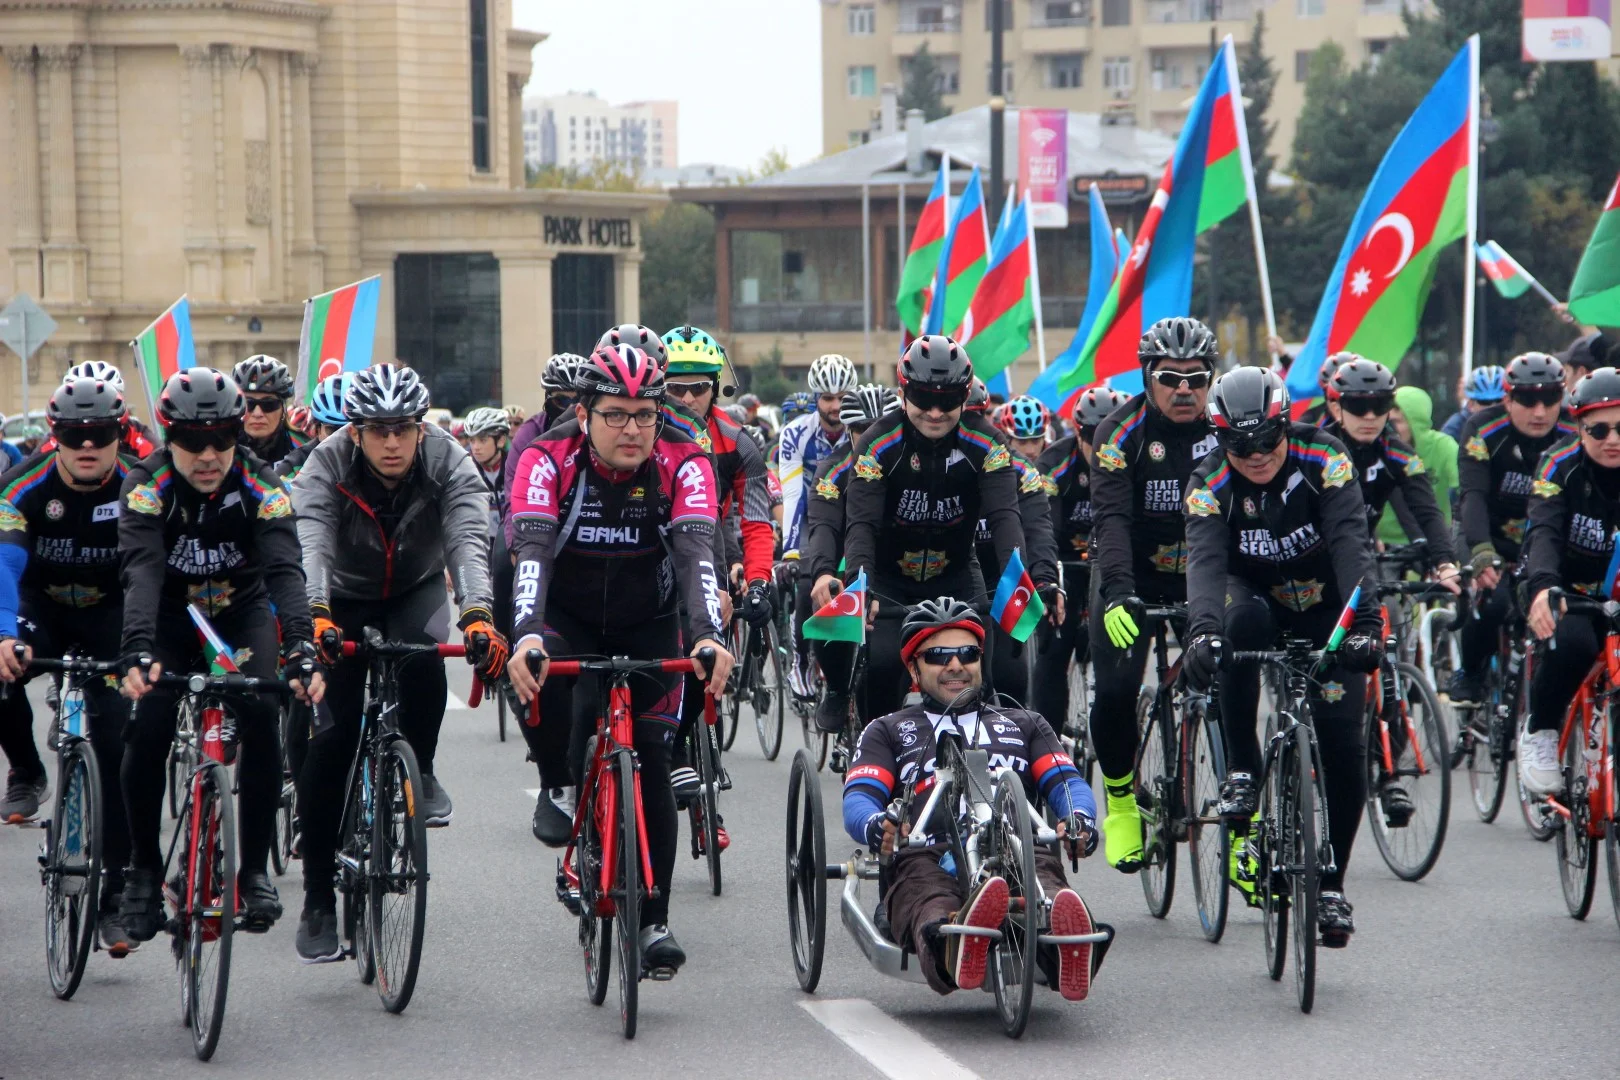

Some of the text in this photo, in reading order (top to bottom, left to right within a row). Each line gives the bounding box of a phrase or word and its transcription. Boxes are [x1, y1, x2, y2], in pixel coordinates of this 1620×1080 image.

[544, 215, 636, 248] PARK HOTEL
[1237, 418, 1259, 428] GIRO
[1146, 479, 1179, 490] STATE
[97, 508, 114, 517] DTX
[899, 495, 960, 513] SECURTY
[1573, 513, 1603, 530] STATE
[576, 525, 640, 544] BAKU
[1239, 523, 1315, 556] SECURITY
[1240, 529, 1273, 542] STATE
[514, 560, 540, 627] BAK
